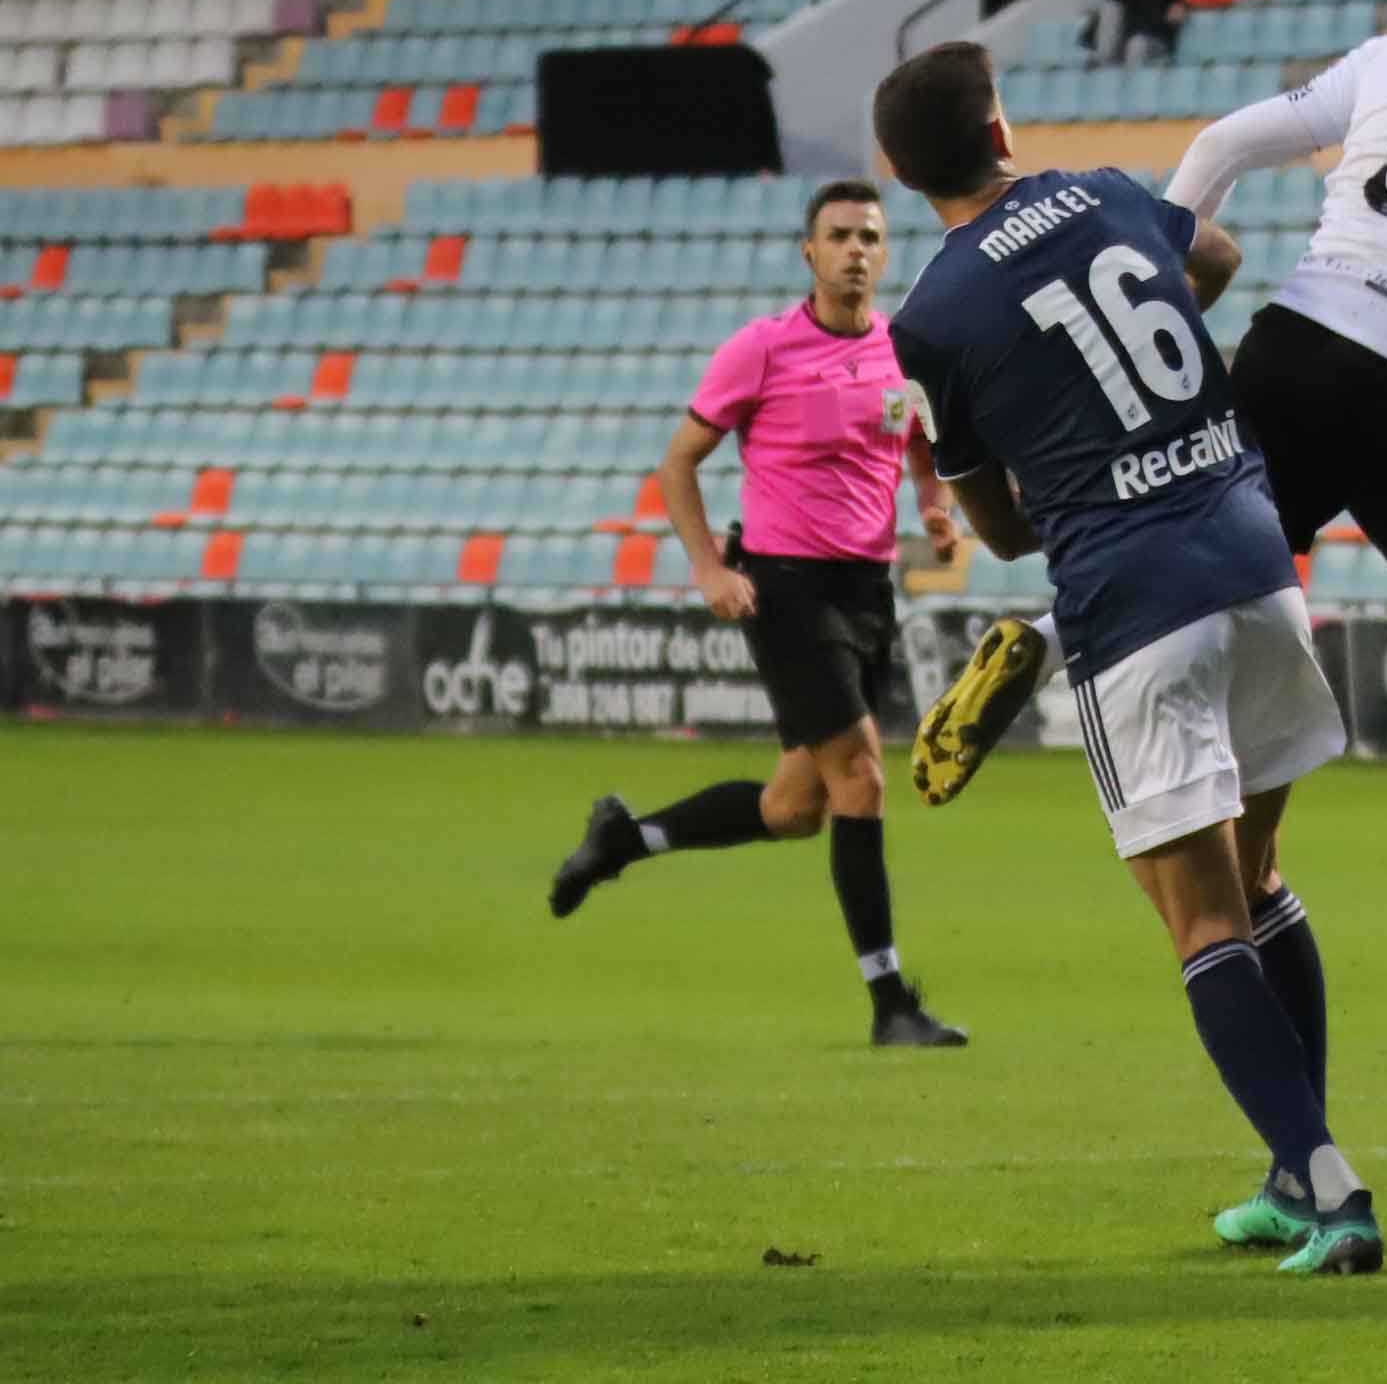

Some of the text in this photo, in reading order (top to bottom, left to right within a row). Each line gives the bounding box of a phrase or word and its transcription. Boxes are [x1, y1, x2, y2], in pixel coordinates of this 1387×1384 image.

[979, 186, 1100, 262] MARKEL
[1021, 245, 1204, 432] 16
[1111, 410, 1244, 500] Recalvi
[567, 614, 665, 680] pintor
